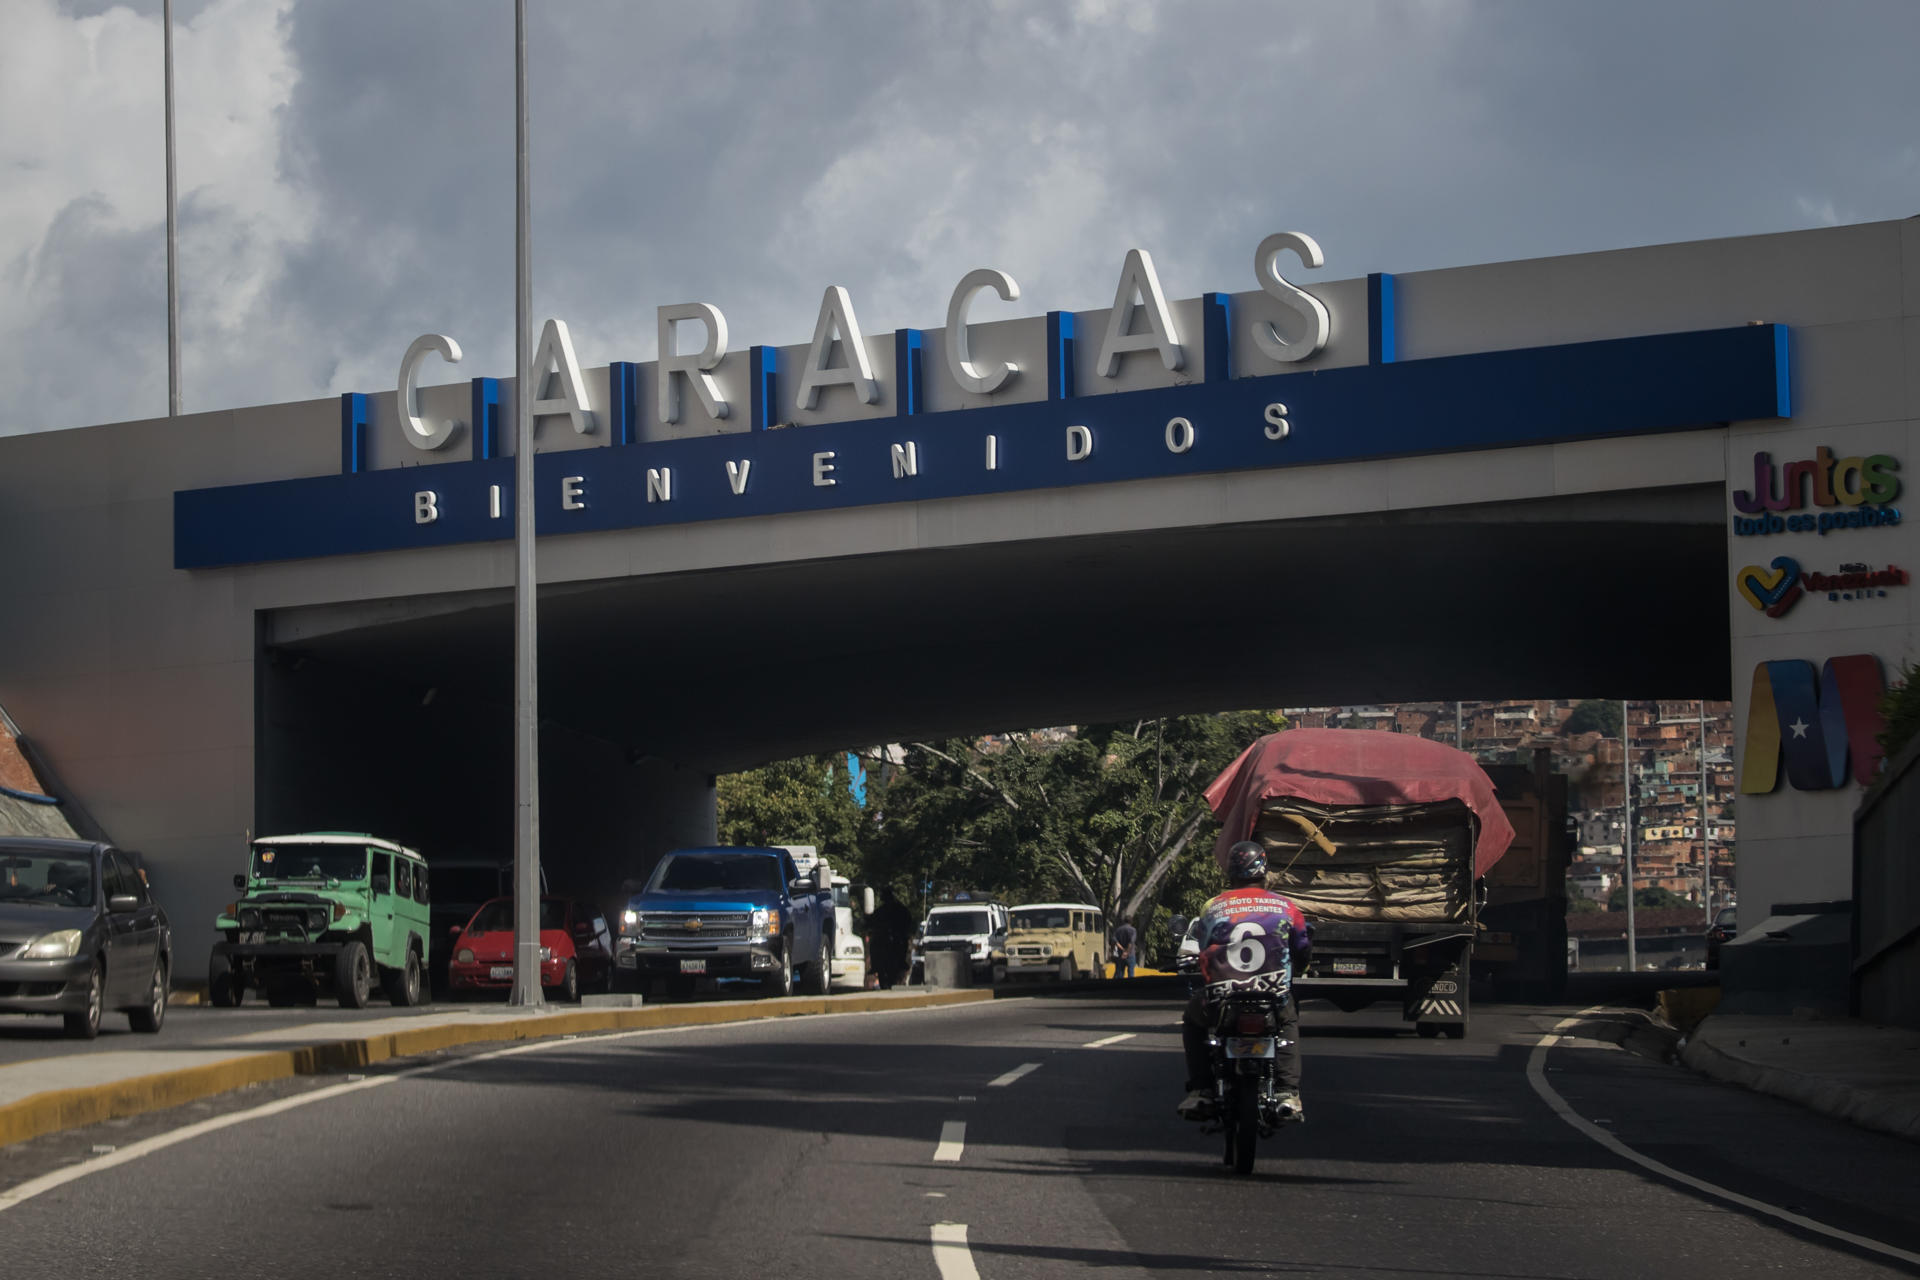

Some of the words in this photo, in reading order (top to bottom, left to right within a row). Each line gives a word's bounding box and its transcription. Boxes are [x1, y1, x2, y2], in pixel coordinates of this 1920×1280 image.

[397, 231, 1331, 450] CARACAS
[414, 403, 1290, 525] BIENVENIDOS
[1733, 445, 1899, 514] Juntos
[1733, 512, 1784, 536] todo
[1786, 513, 1816, 532] es
[1818, 504, 1901, 536] posible
[1225, 905, 1283, 915] DELINCUENTES
[1229, 897, 1252, 907] MOTO
[1226, 922, 1266, 973] 6
